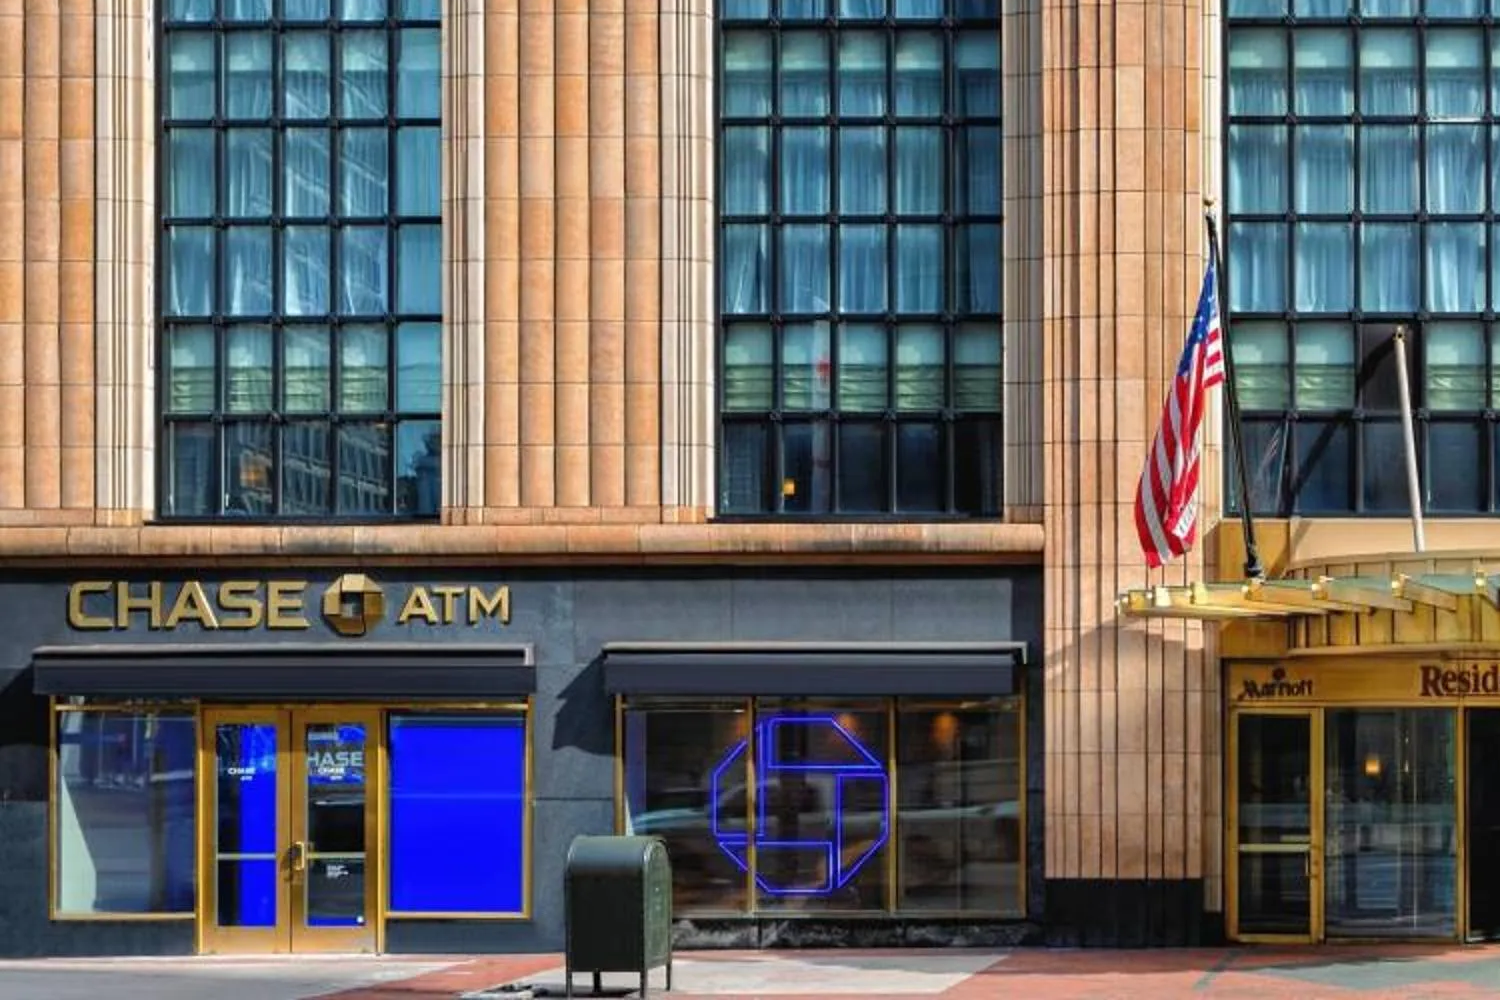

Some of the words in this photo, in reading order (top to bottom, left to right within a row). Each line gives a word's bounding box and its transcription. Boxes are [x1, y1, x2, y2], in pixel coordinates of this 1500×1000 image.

[66, 581, 310, 630] CHASE
[398, 585, 510, 625] ATM
[1237, 668, 1313, 701] Marriott
[307, 751, 364, 767] HASE
